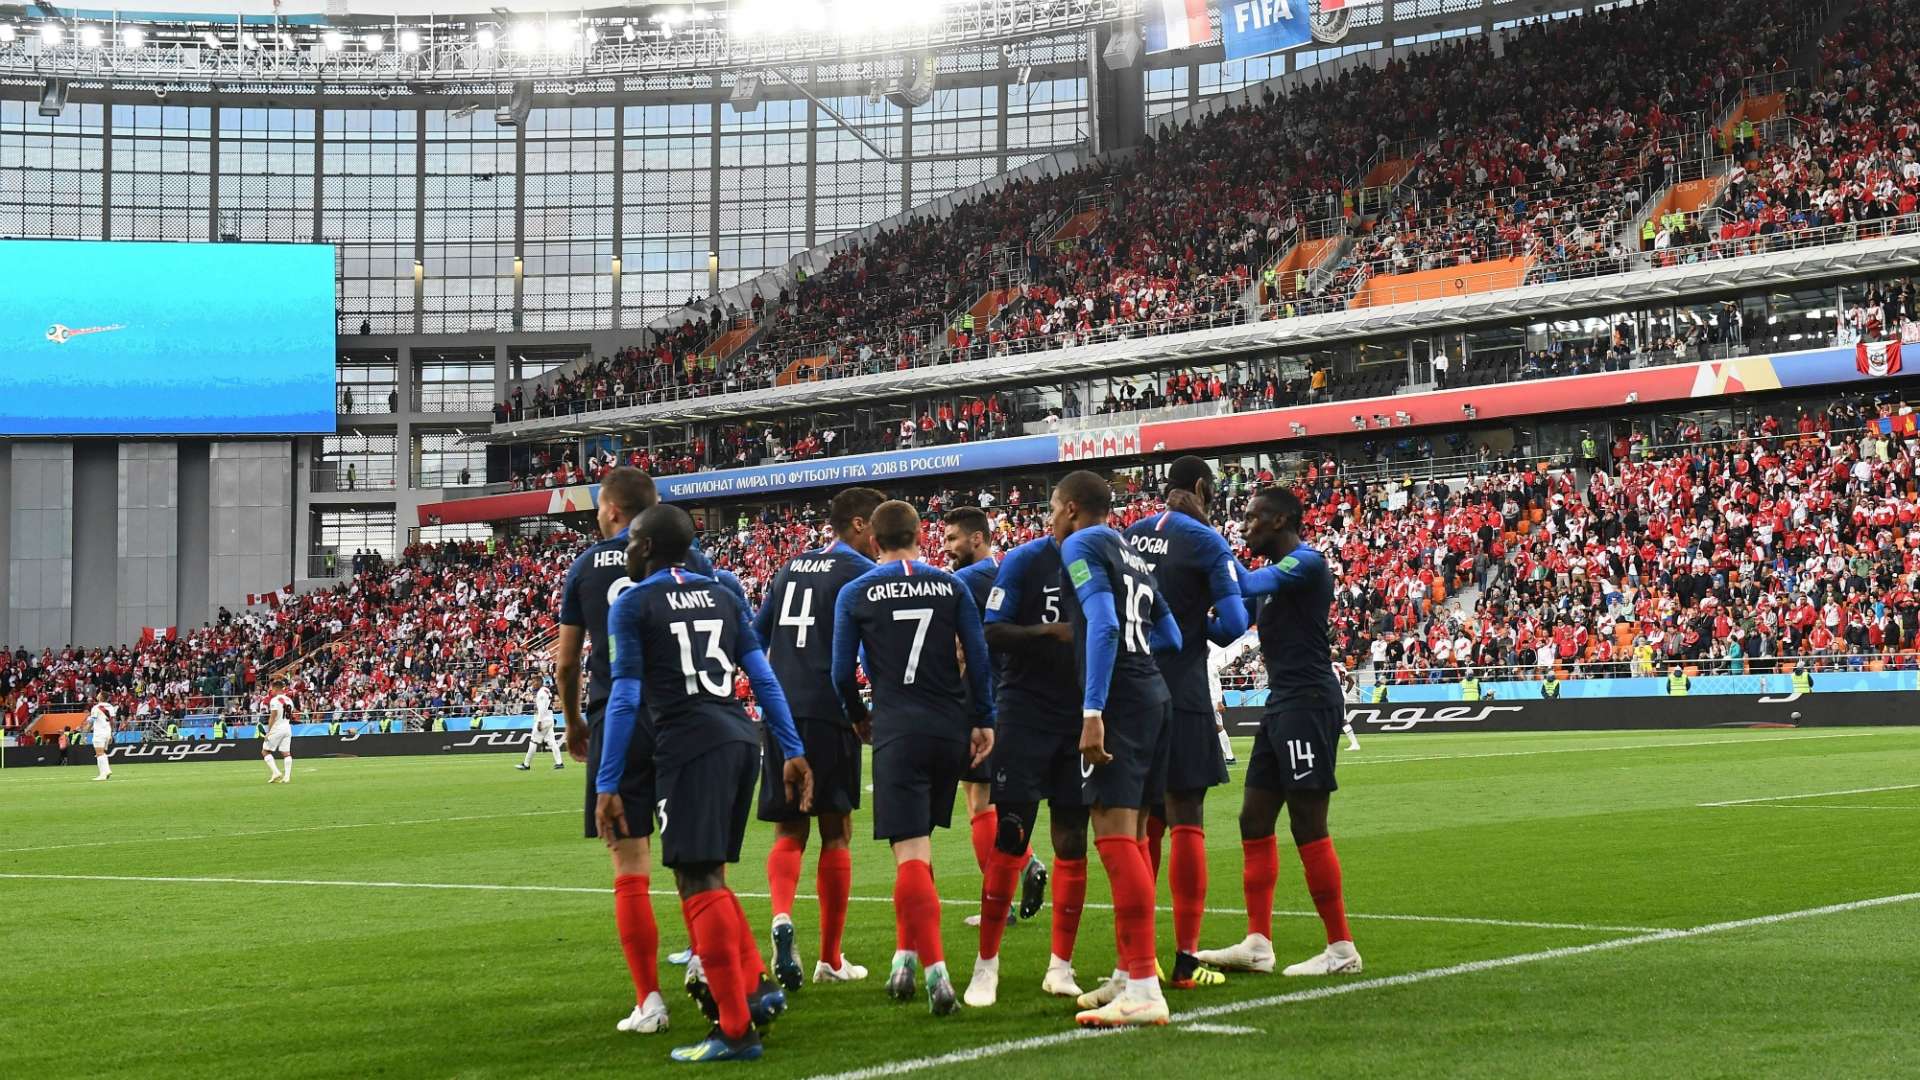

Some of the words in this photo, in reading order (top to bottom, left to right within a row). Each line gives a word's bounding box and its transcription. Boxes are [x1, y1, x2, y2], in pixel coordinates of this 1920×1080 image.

[1233, 0, 1294, 33] FIFA
[670, 478, 734, 496] ЧЕМПИОНАТ
[736, 475, 768, 489] МИРА
[770, 472, 786, 485] ПО
[788, 466, 840, 484] ФУТБОЛУ
[843, 464, 866, 478] FIFA
[871, 460, 898, 476] 2018
[899, 460, 908, 472] В
[910, 454, 960, 471] РОССИИ
[1130, 534, 1169, 555] POGBA
[789, 559, 836, 573] VARANE
[665, 590, 717, 611] KANTE
[866, 580, 954, 602] GRIEZMANN
[778, 581, 816, 648] 4
[1041, 595, 1060, 624] 5
[1122, 573, 1154, 655] 10
[669, 619, 734, 697] 13
[892, 608, 934, 685] 7
[1346, 706, 1524, 731] nger
[107, 743, 236, 761] stinger
[1287, 740, 1315, 770] 14
